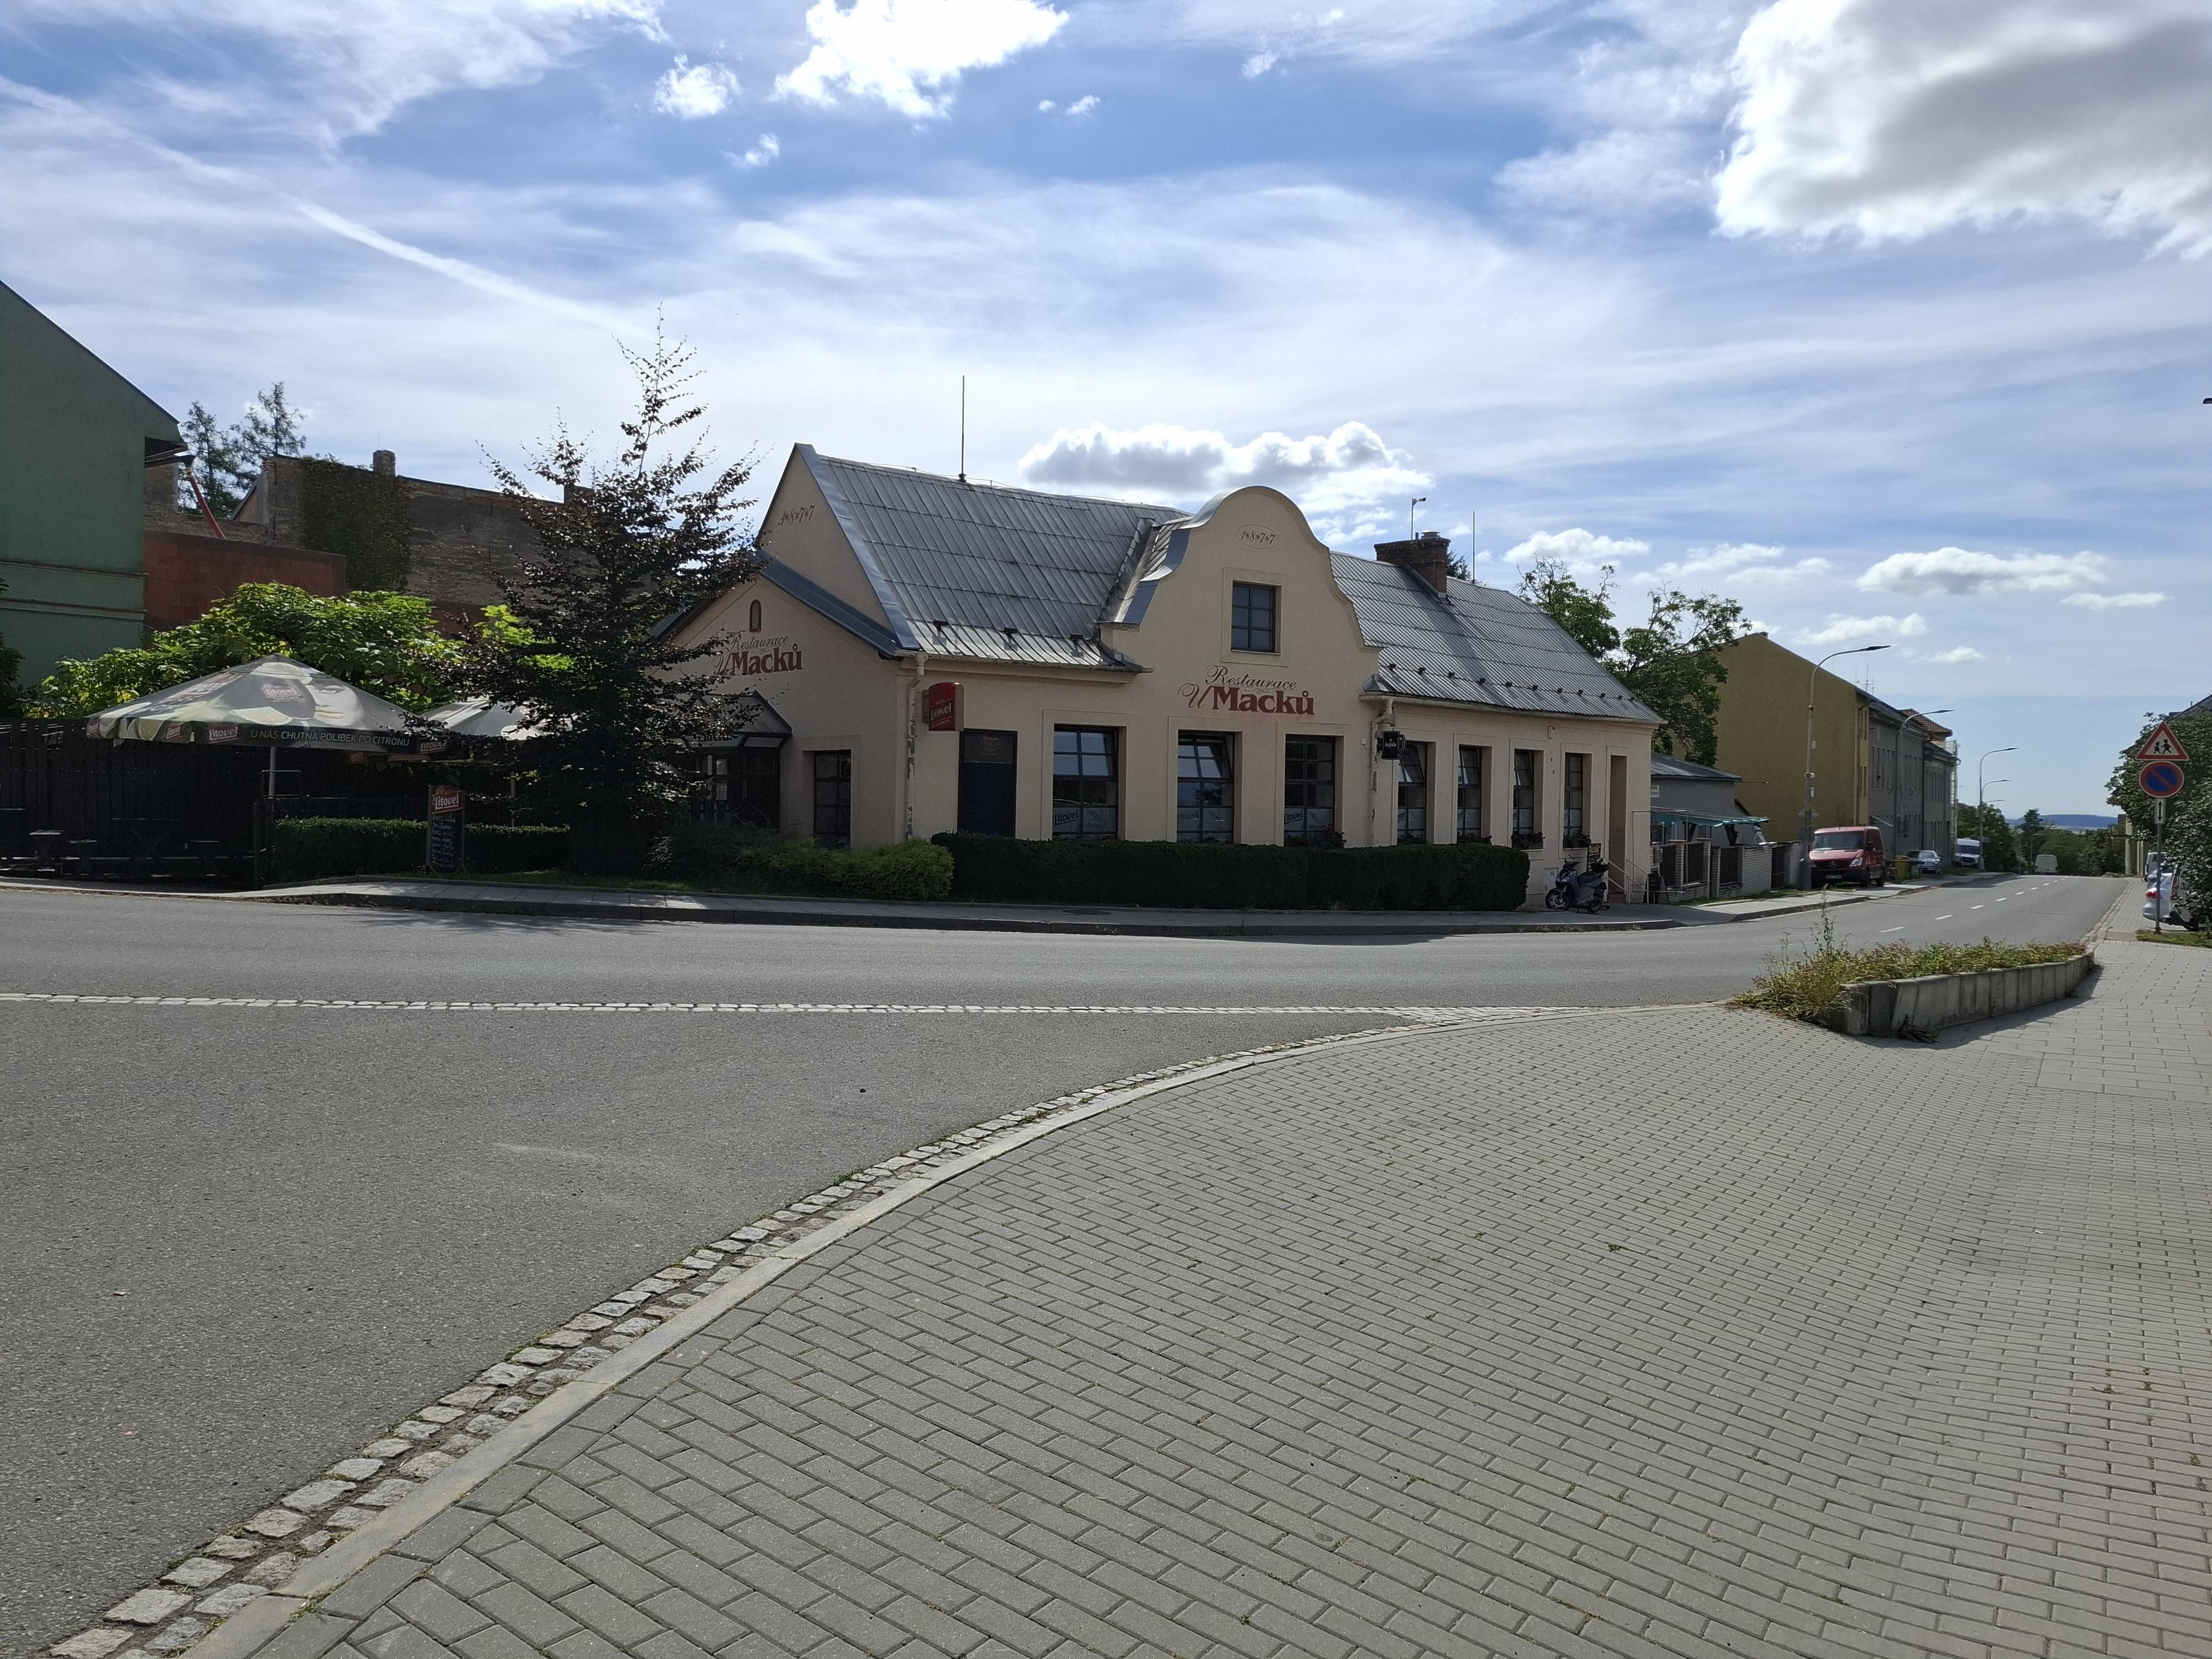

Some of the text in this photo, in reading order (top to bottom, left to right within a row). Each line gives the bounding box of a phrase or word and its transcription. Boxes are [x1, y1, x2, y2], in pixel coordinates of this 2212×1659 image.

[726, 633, 789, 651] Restaurace
[731, 643, 803, 676] Macků
[1205, 665, 1297, 690] Restaurace
[1178, 683, 1315, 715] U Macků
[931, 702, 952, 721] Litovel
[208, 726, 238, 740] Litovel
[251, 729, 258, 738] U
[259, 729, 279, 739] NÁS
[281, 731, 318, 742] CHUTNÁ
[320, 733, 357, 743] POLIBEK
[373, 736, 410, 747] CITRONU
[435, 793, 460, 810] Litovel
[1054, 809, 1079, 826] Litovel
[1285, 810, 1303, 823] itovel
